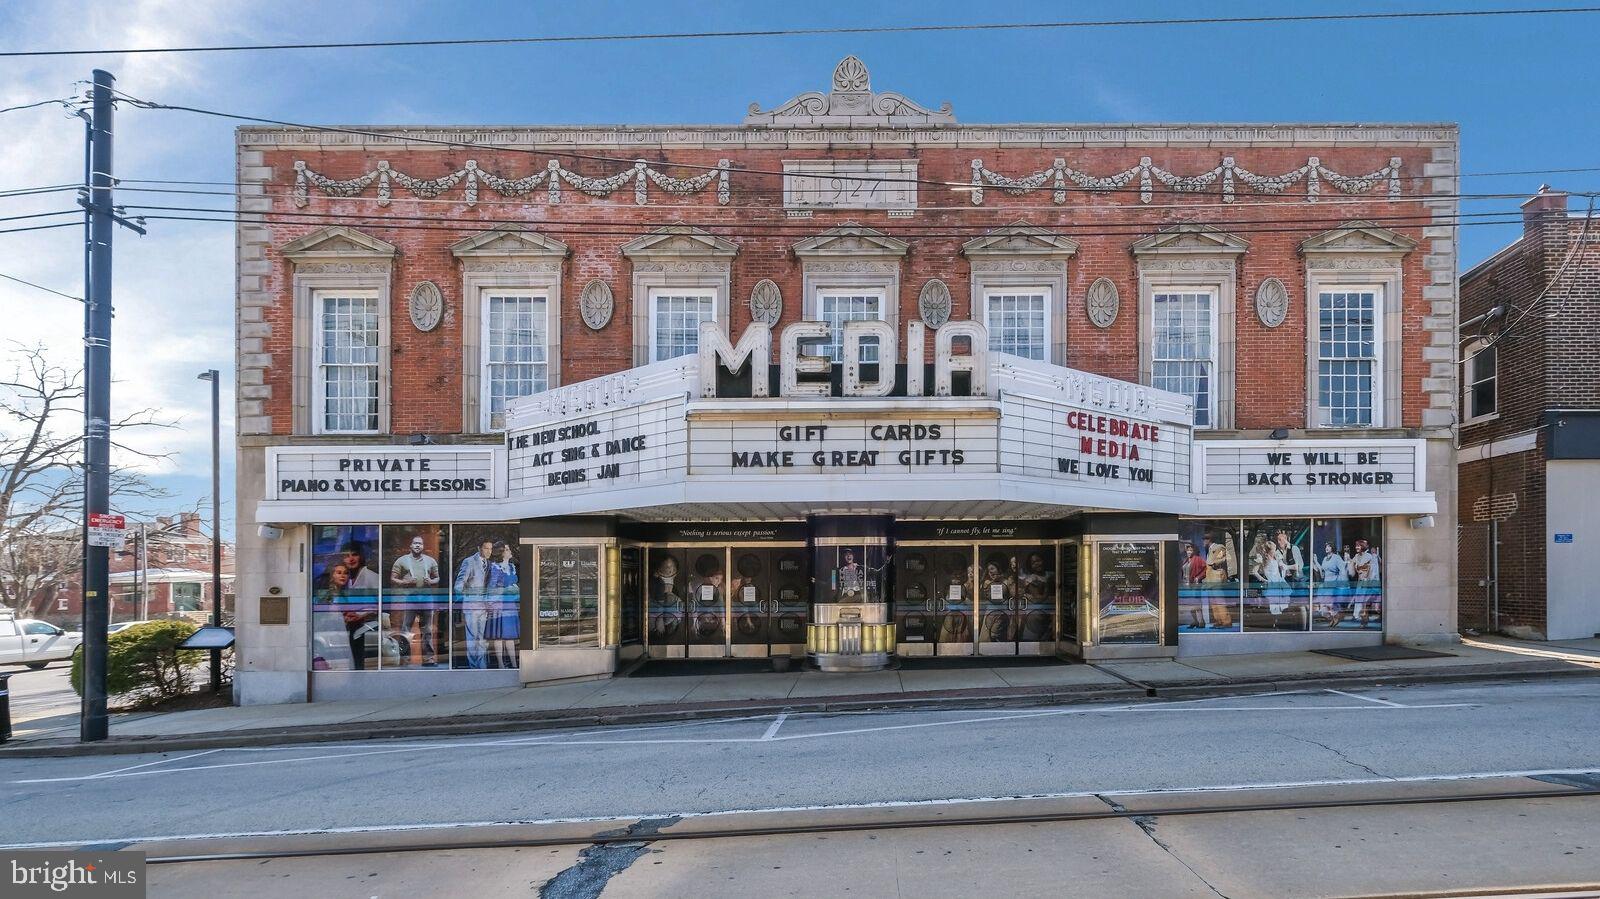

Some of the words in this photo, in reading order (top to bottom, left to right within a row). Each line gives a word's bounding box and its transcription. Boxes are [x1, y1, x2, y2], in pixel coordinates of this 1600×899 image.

[818, 178, 881, 199] 1927
[700, 320, 988, 398] MEDIA
[508, 435, 528, 450] THE
[533, 429, 556, 446] NEW
[558, 421, 600, 441] SCHOOL
[779, 425, 828, 441] GIFT
[870, 424, 941, 440] CARDS
[1067, 411, 1159, 442] CELEBRATE
[533, 451, 554, 467] ACT
[561, 446, 585, 462] SING
[591, 443, 600, 457] &
[606, 435, 646, 455] DANCE
[732, 451, 794, 468] MAKE
[812, 450, 879, 467] GREAT
[899, 449, 964, 466] GIFTS
[1081, 436, 1140, 461] MEDIA
[1267, 453, 1292, 465] WE
[1303, 453, 1343, 465] WILL
[1358, 452, 1378, 464] BE
[339, 459, 431, 472] PRIVATE
[548, 469, 586, 486] BEGINS
[597, 463, 620, 479] JAN
[1058, 458, 1079, 474] WE
[1087, 462, 1119, 479] LOVE
[1129, 467, 1153, 482] YOU
[282, 479, 329, 492] PIANO
[334, 479, 345, 492] &
[351, 479, 402, 492] VOICE
[410, 478, 486, 491] LESSONS
[1247, 473, 1293, 485] BACK
[1306, 472, 1394, 485] STRONGER
[733, 529, 751, 537] except
